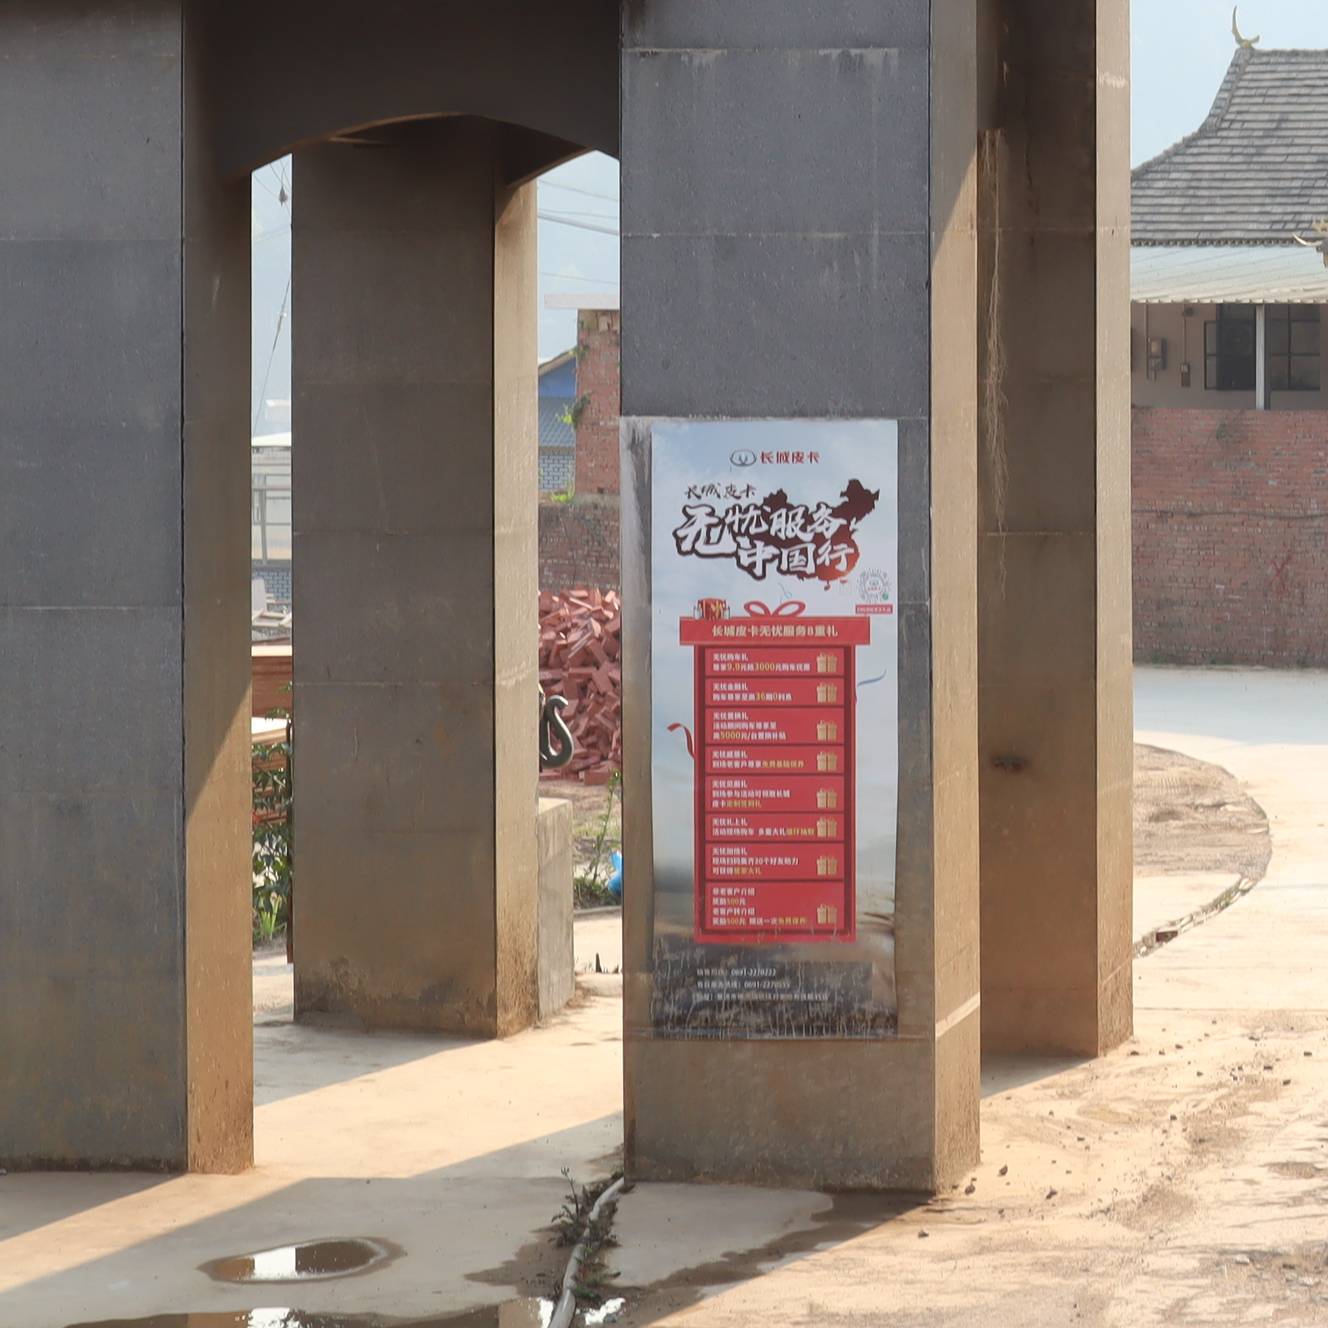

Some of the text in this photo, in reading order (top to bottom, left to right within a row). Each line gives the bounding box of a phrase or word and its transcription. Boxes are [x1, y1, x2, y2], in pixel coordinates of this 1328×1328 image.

[760, 451, 821, 464] 长城皮卡
[684, 482, 756, 500] 长城皮卡
[676, 505, 848, 555] 无忧服务
[736, 537, 854, 580] 中国行
